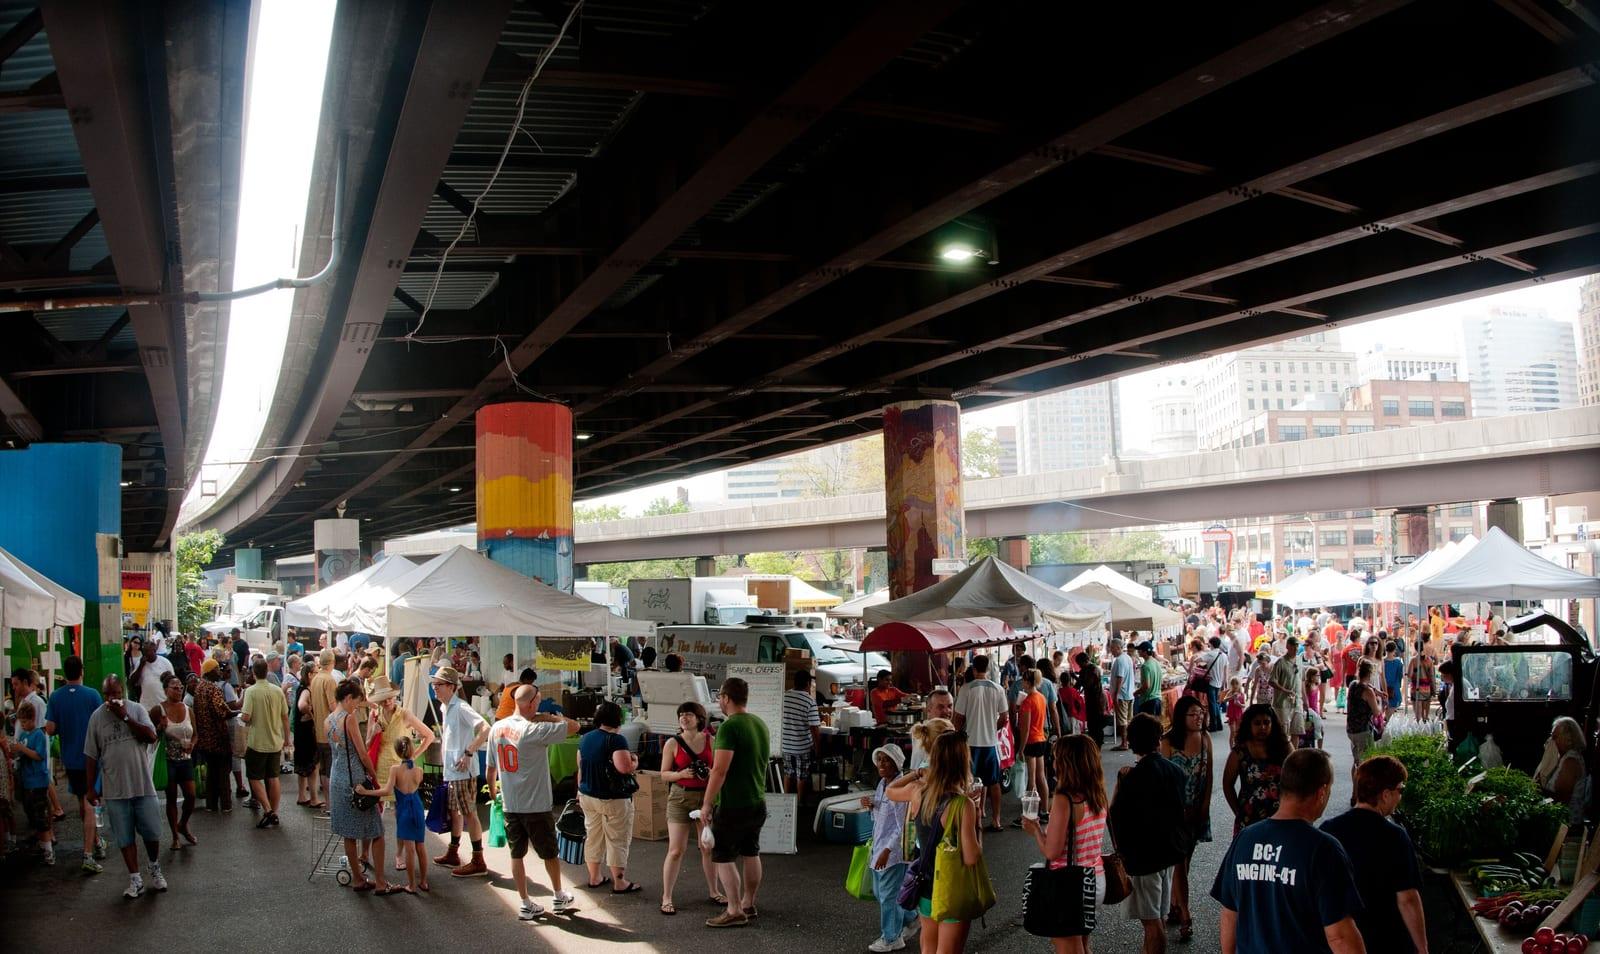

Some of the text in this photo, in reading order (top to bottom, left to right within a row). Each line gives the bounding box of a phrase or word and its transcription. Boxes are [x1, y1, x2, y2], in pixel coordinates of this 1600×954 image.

[678, 640, 690, 652] The
[497, 743, 518, 773] 10
[1252, 843, 1283, 862] BC-1
[1236, 863, 1297, 885] ENGINE-41
[1022, 871, 1033, 914] RBAN
